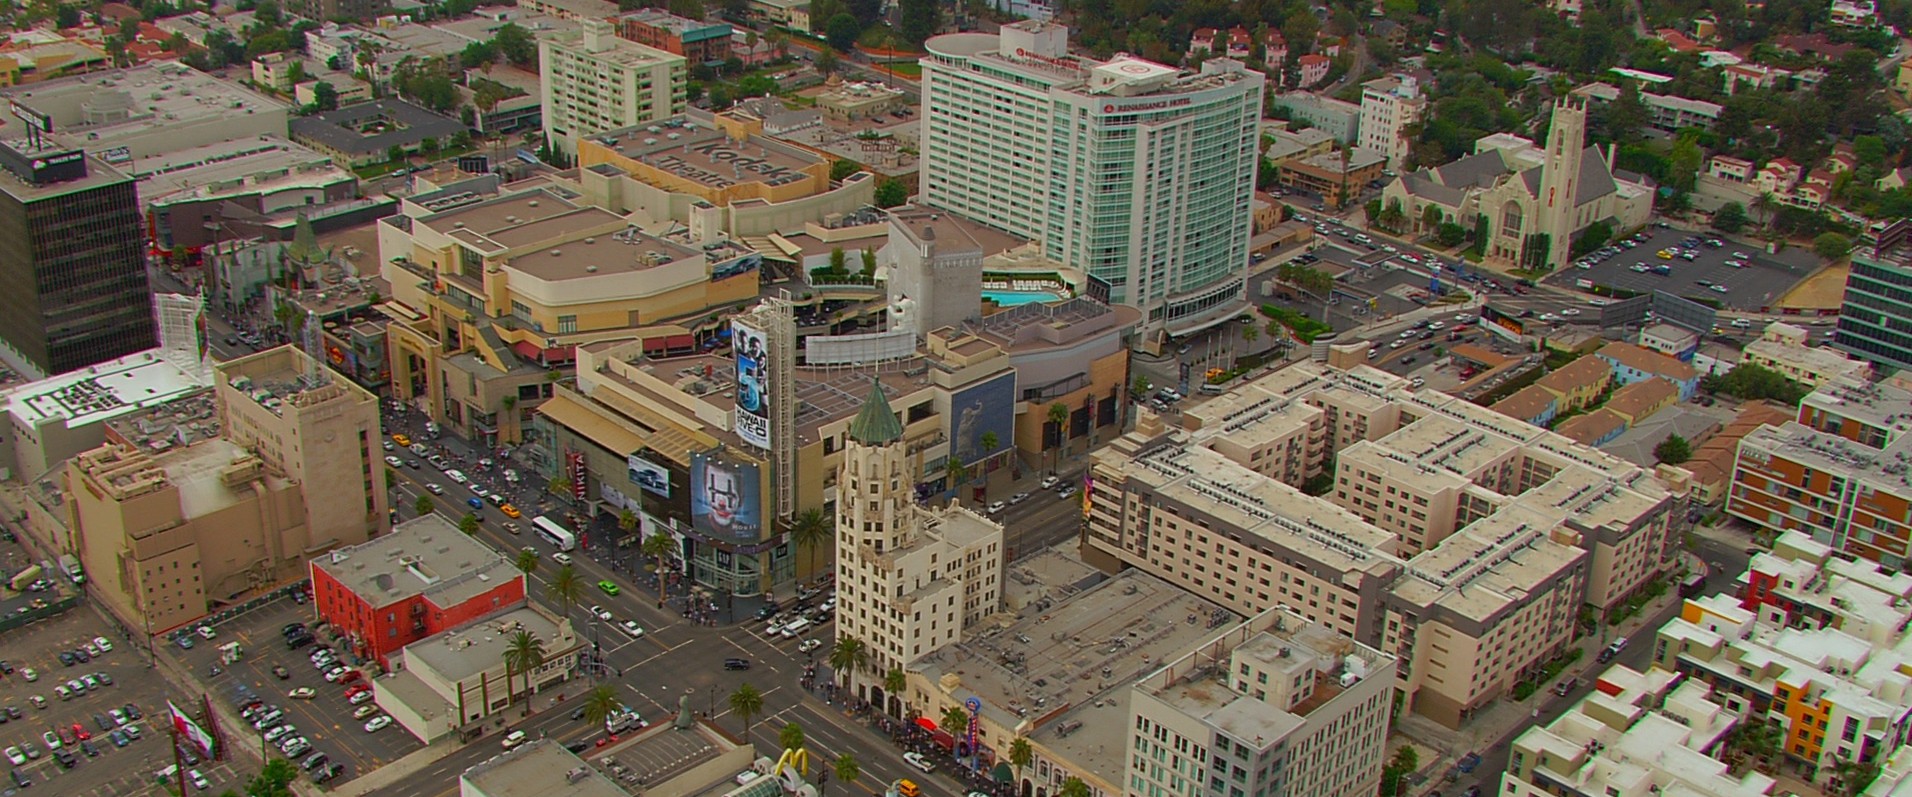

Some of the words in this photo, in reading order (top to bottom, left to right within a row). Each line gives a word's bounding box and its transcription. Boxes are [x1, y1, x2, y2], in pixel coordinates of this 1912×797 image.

[1117, 101, 1167, 112] RENAISSANCE
[1169, 98, 1191, 107] HOTEL
[659, 155, 736, 188] Theatre
[694, 144, 793, 178] Kodak
[576, 455, 585, 500] NIKITA
[718, 552, 729, 564] GAP
